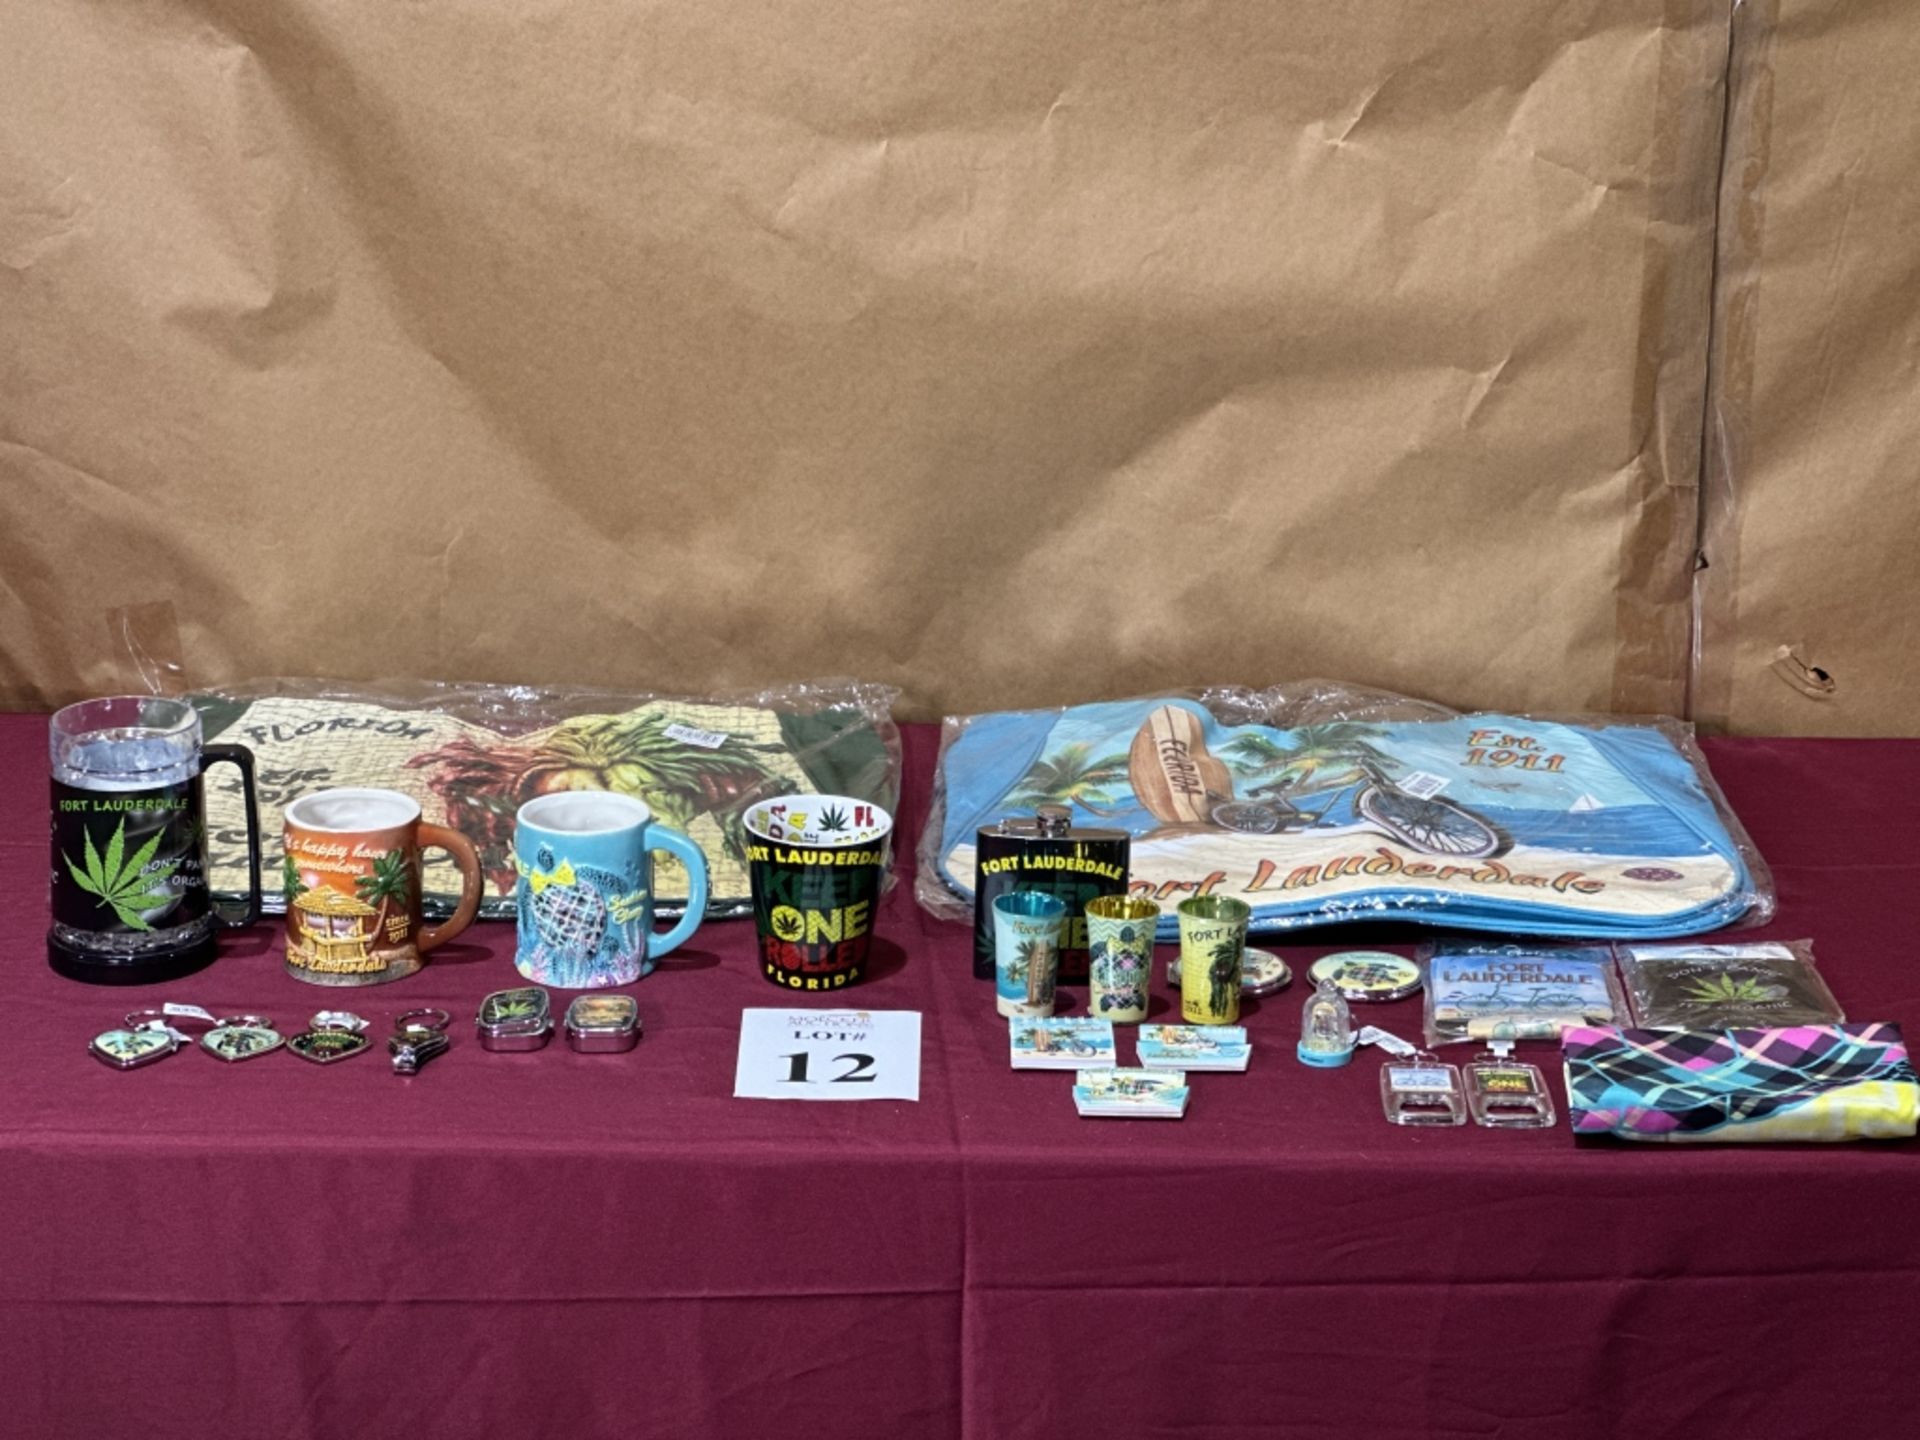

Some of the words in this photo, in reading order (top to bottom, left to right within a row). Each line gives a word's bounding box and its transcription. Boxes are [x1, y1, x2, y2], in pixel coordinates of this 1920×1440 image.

[1467, 729, 1547, 750] Est.
[1461, 748, 1566, 773] 1911
[60, 799, 88, 811] FORT
[94, 798, 188, 811] LAUDERDALE
[854, 806, 875, 828] FL
[301, 837, 348, 859] happy
[746, 846, 769, 861] ORT
[774, 849, 886, 866] LAUDERDA
[980, 856, 1019, 877] FORT
[1023, 855, 1124, 880] LAUDERDALE
[1128, 871, 1227, 900] ort
[1242, 846, 1606, 893] Lauderdale
[771, 899, 870, 945] ONE
[1187, 929, 1221, 944] FORT
[767, 963, 860, 990] FLORIDA
[1443, 971, 1593, 984] LAUDERDALE
[1487, 962, 1545, 973] FORT
[794, 1030, 866, 1041] LOT#
[776, 1052, 878, 1084] 12
